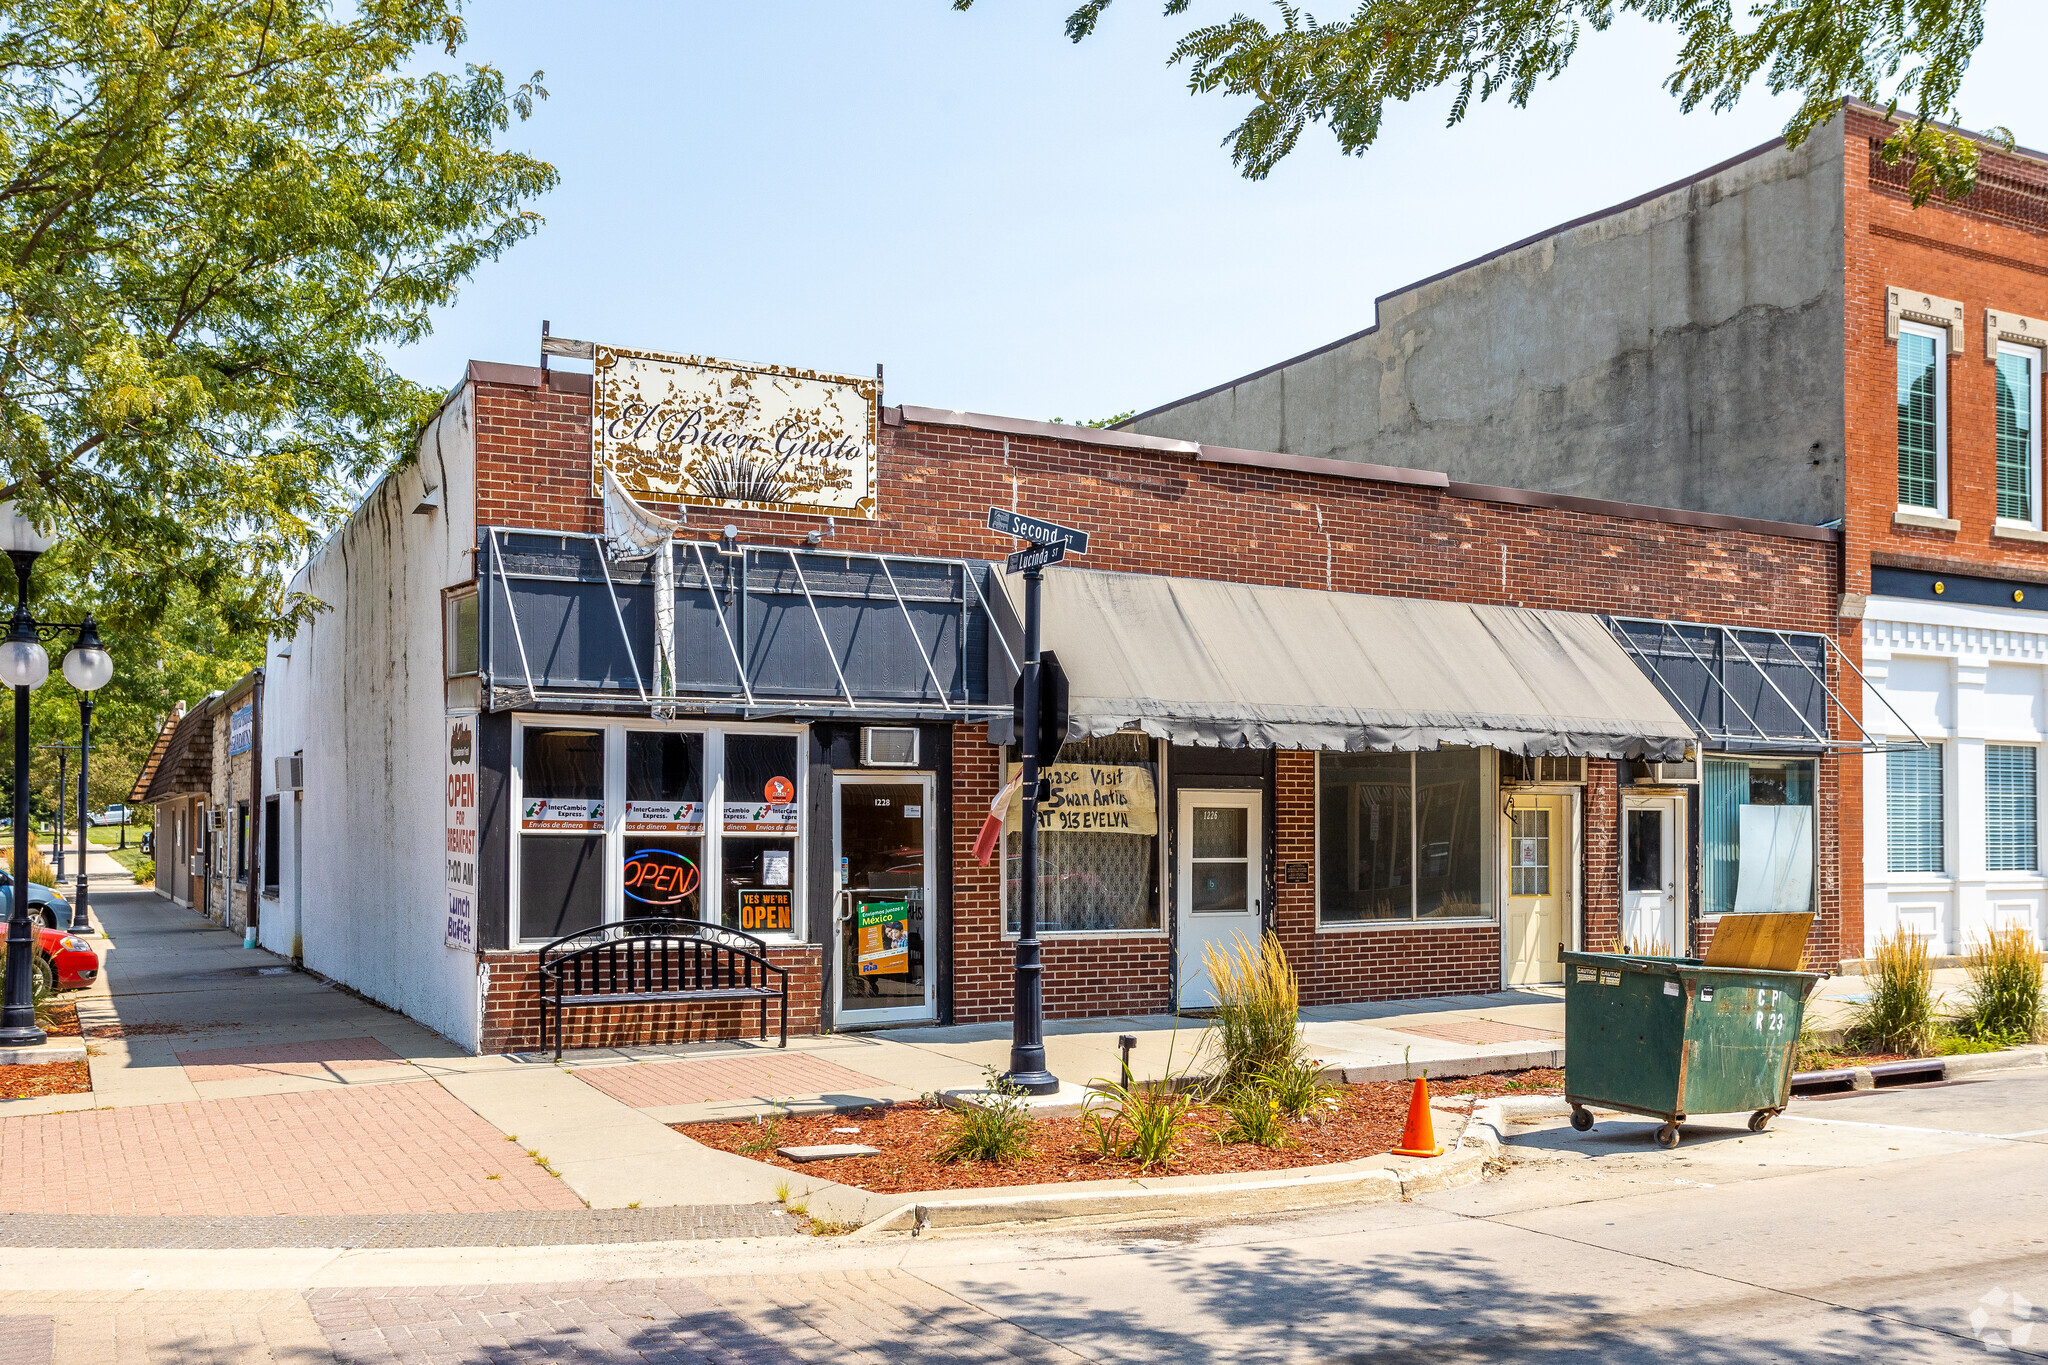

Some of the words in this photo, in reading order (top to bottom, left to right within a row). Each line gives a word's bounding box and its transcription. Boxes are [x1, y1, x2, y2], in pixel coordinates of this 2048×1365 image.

[608, 398, 660, 440] El
[656, 405, 763, 452] Buen
[775, 417, 863, 470] Gusto
[1012, 516, 1058, 542] Second
[1064, 534, 1073, 544] ST
[1018, 548, 1049, 569] Lucinda
[1051, 547, 1059, 557] ST
[1090, 767, 1124, 786] Visit
[448, 773, 474, 808] OPEN
[1048, 787, 1090, 808] Swan
[455, 810, 465, 826] FOR
[1059, 811, 1080, 829] 913
[1083, 811, 1129, 828] EVELYN
[1203, 810, 1219, 820] 1226
[447, 828, 476, 855] BREAKFAST
[448, 859, 461, 884] 7:00
[462, 862, 474, 886] AM
[624, 861, 694, 893] OPEN
[449, 892, 470, 918] Lunch
[744, 894, 760, 904] YES
[763, 894, 788, 905] WE'RE
[742, 906, 791, 929] OPEN
[862, 914, 893, 926] México
[447, 916, 471, 944] Buffet
[862, 961, 878, 973] Ria
[1577, 967, 1597, 975] CAUTION
[1601, 970, 1621, 978] CAUTION
[1756, 1010, 1764, 1031] R
[1768, 1012, 1784, 1031] 23
